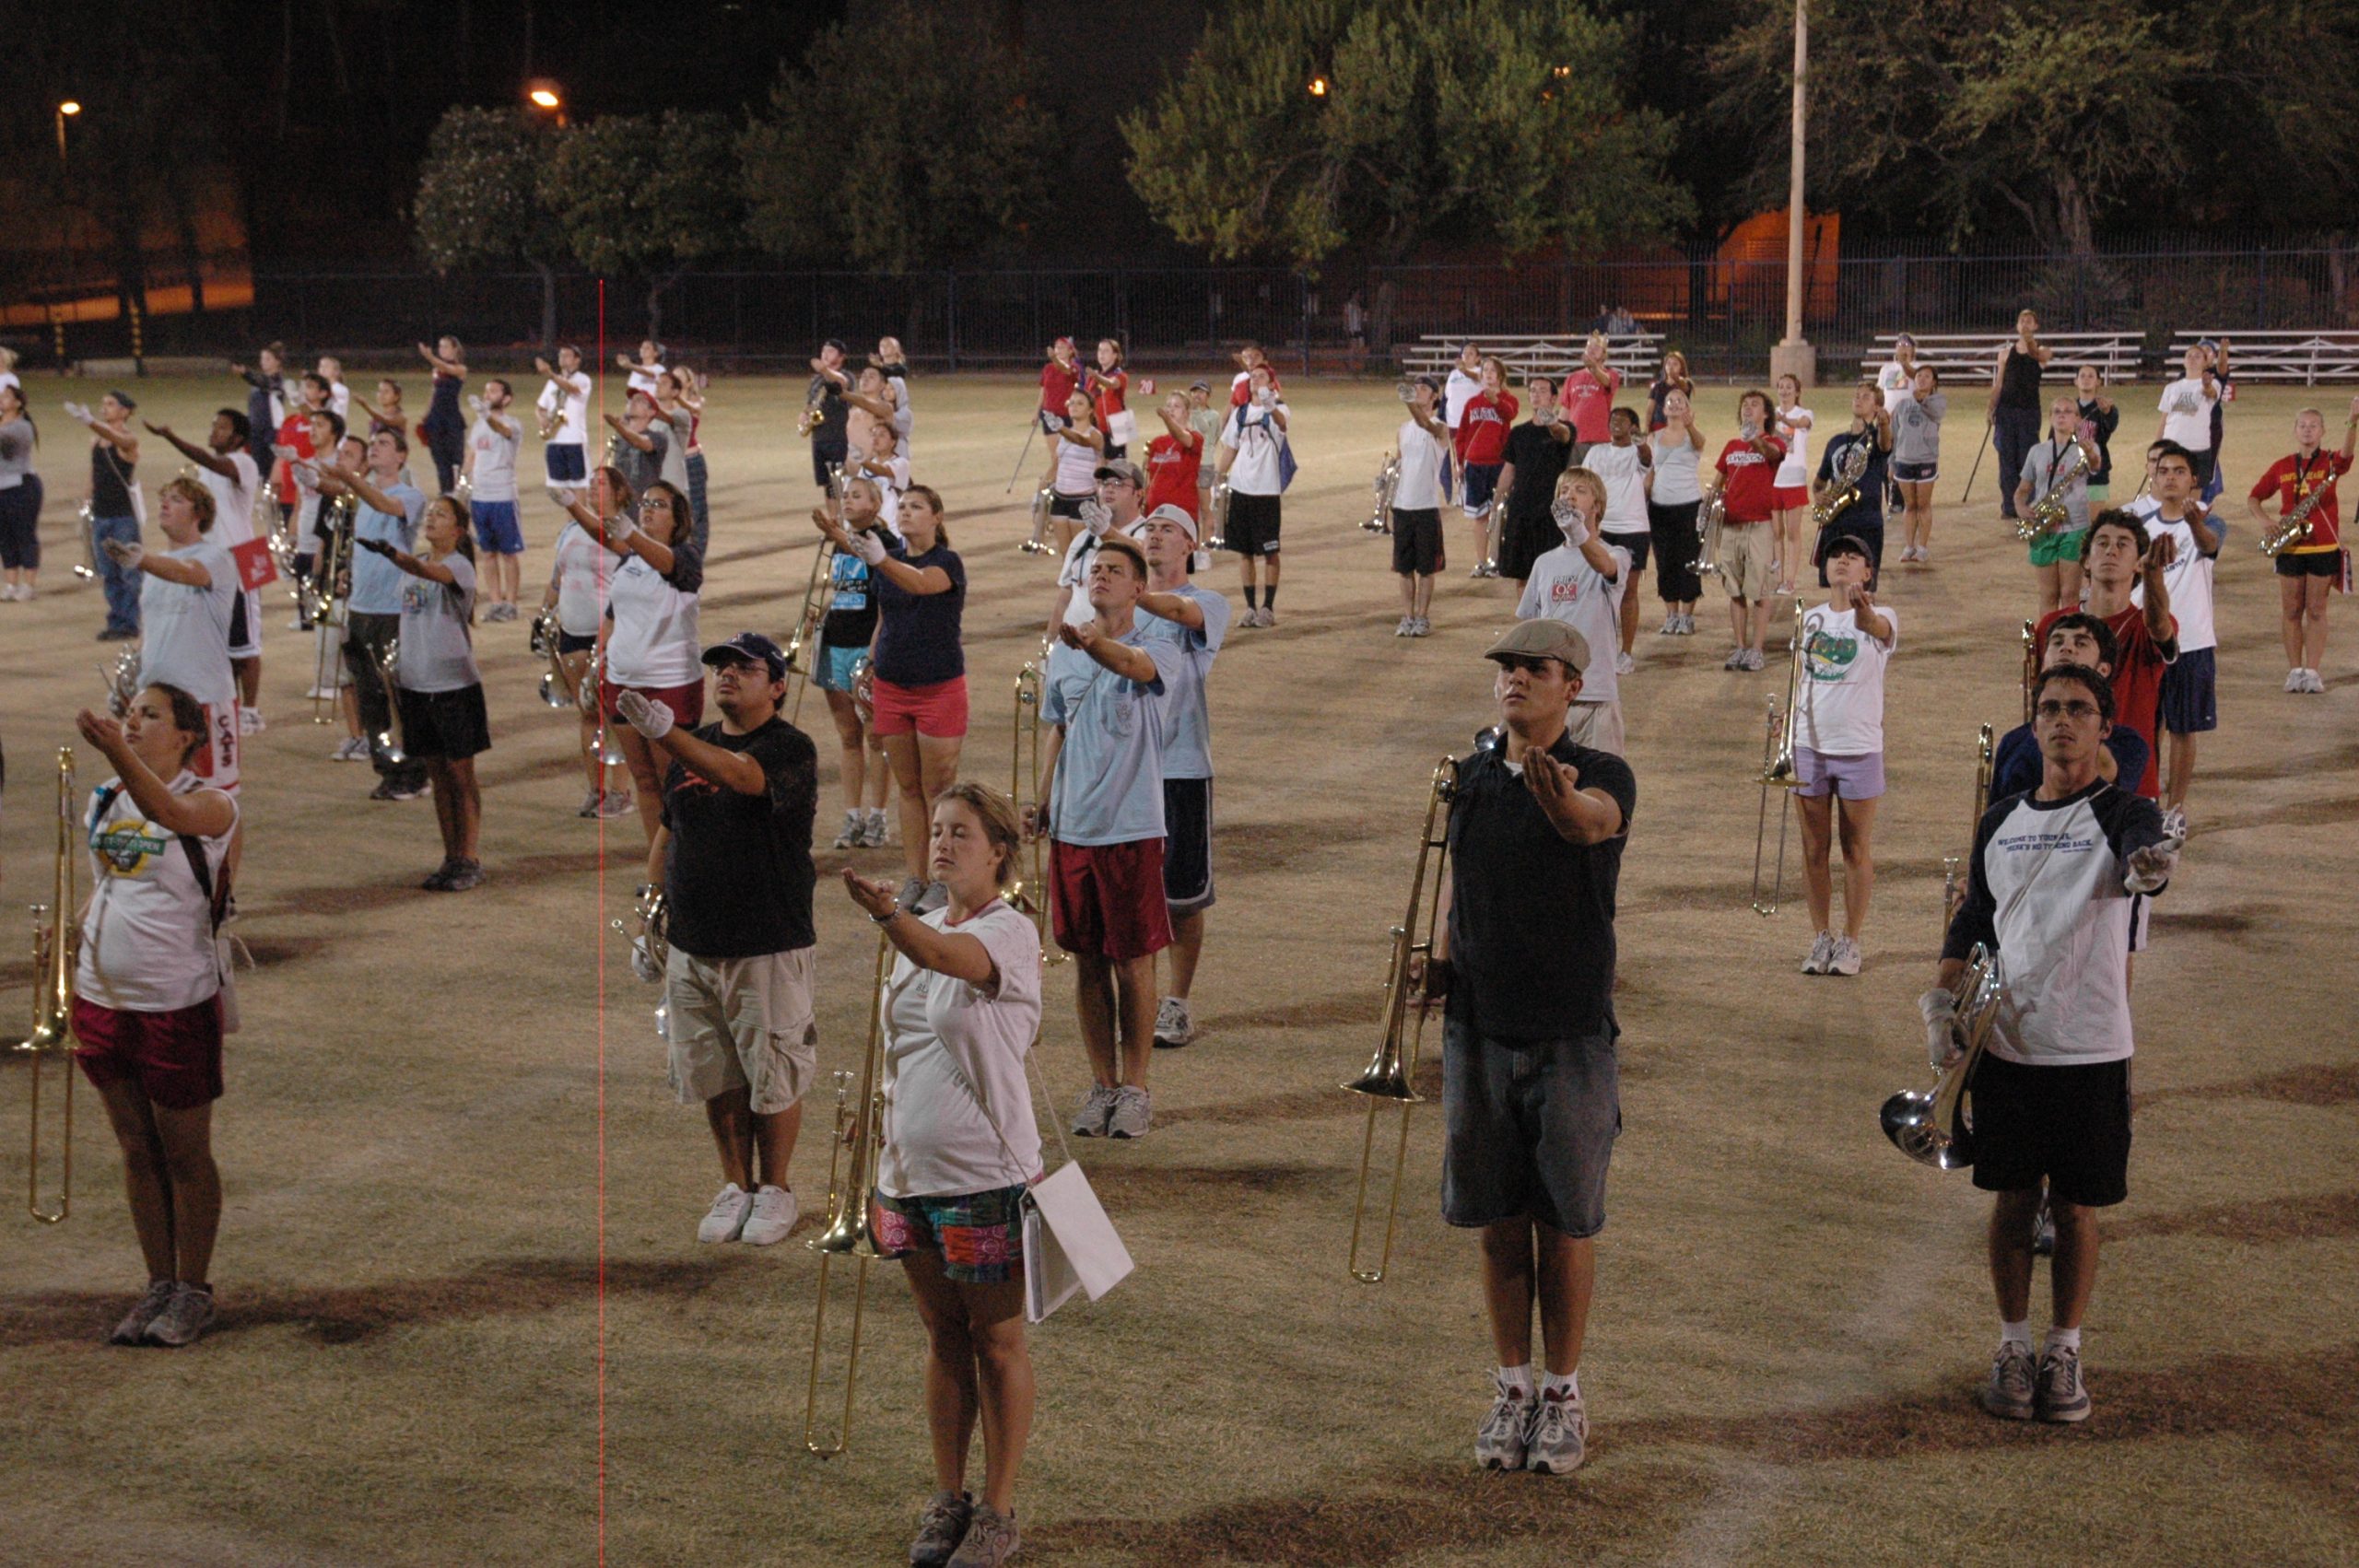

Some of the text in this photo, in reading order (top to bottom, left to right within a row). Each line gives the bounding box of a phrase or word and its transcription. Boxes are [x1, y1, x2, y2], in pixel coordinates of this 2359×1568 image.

[1139, 380, 1154, 394] 20
[217, 715, 234, 767] CATS
[1998, 835, 2026, 846] WELCOME
